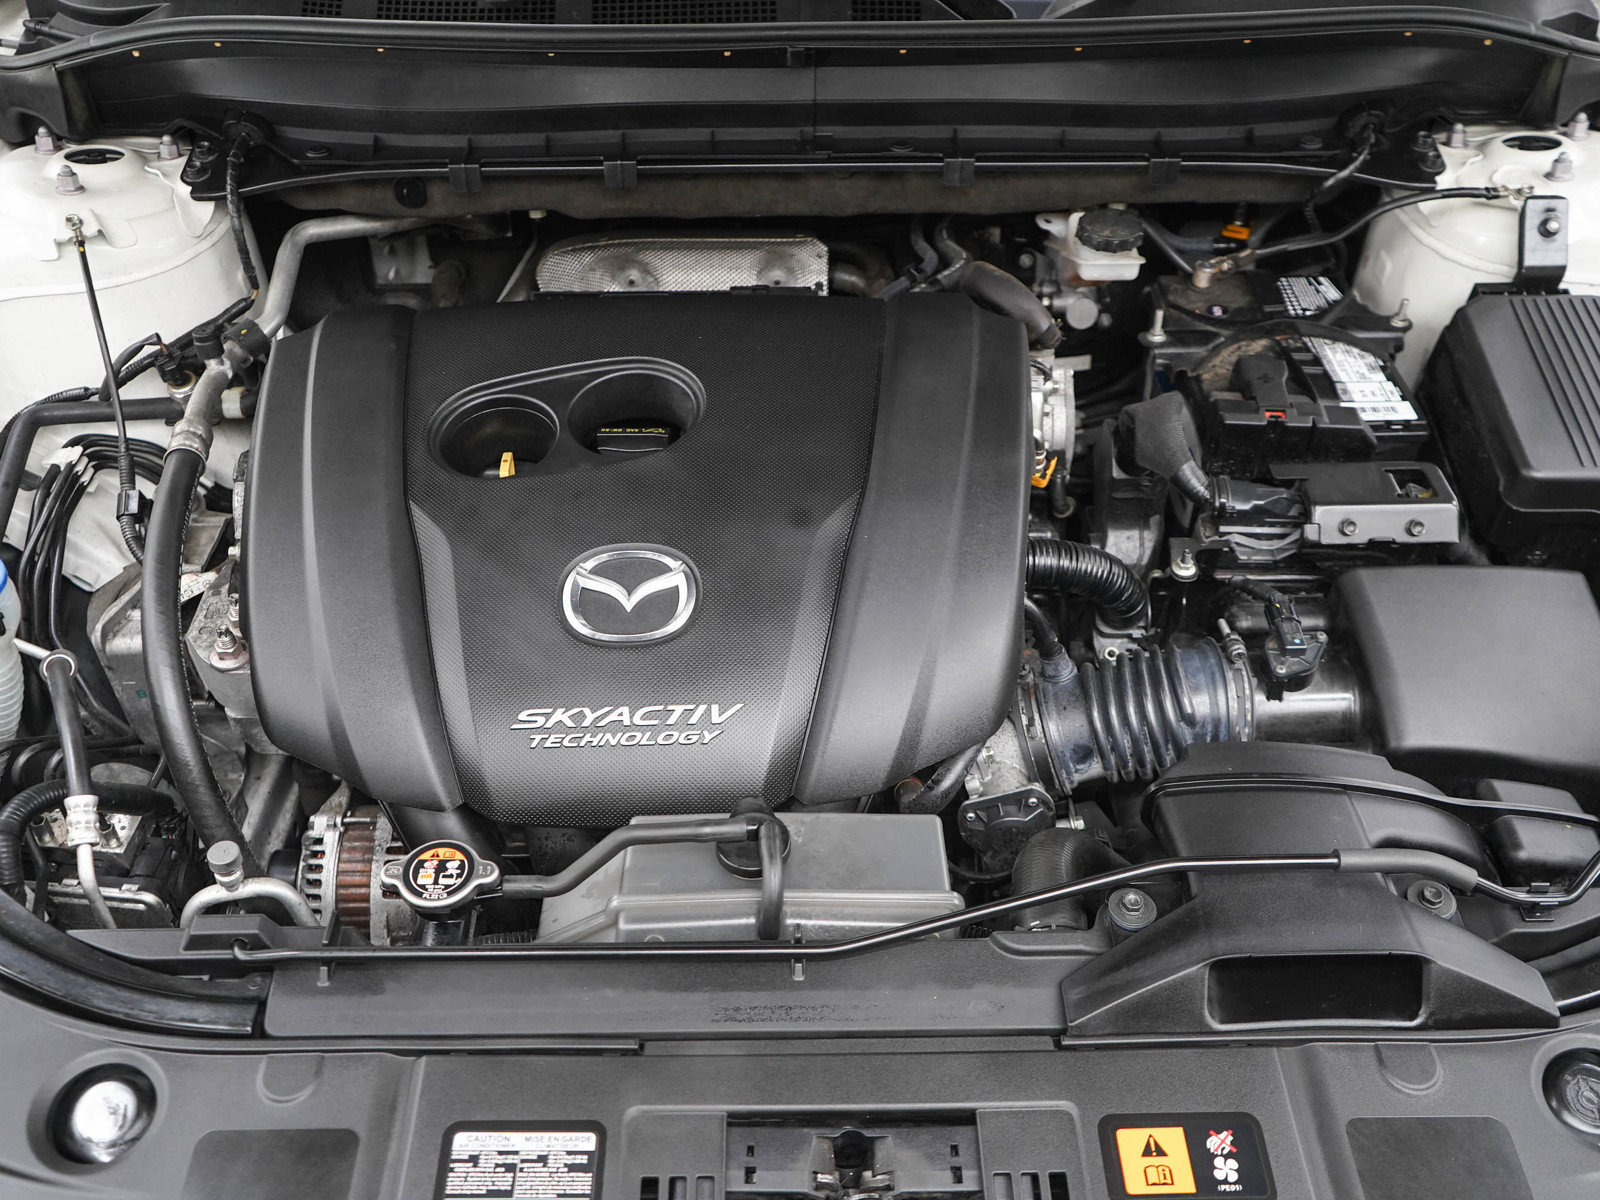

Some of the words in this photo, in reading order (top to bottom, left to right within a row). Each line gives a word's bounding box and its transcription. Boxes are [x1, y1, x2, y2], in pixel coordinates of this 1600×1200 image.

[510, 703, 745, 730] SKYACTIV
[529, 730, 724, 749] TECHNOLOGY
[466, 1134, 511, 1143] CAUTION
[524, 1135, 545, 1143] MISE
[547, 1135, 561, 1143] EN
[561, 1135, 593, 1143] GARDE
